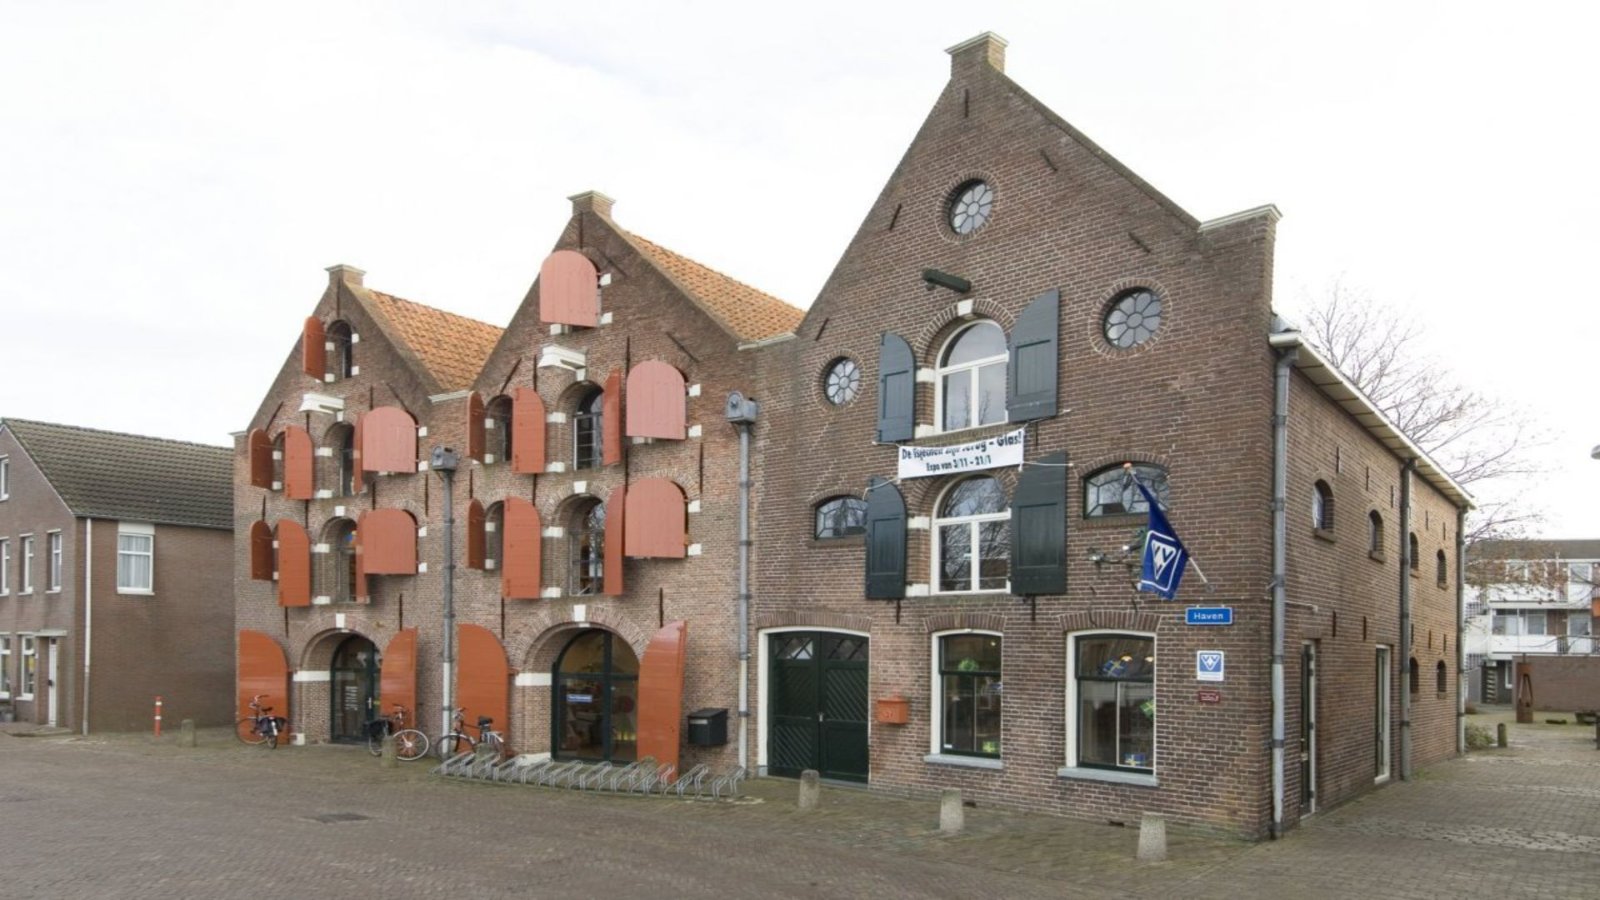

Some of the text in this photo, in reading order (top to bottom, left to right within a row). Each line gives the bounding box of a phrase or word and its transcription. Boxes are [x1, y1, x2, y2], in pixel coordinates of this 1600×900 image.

[902, 449, 912, 460] De
[926, 462, 940, 472] Expo
[941, 462, 952, 470] van
[1193, 612, 1224, 620] Haven
